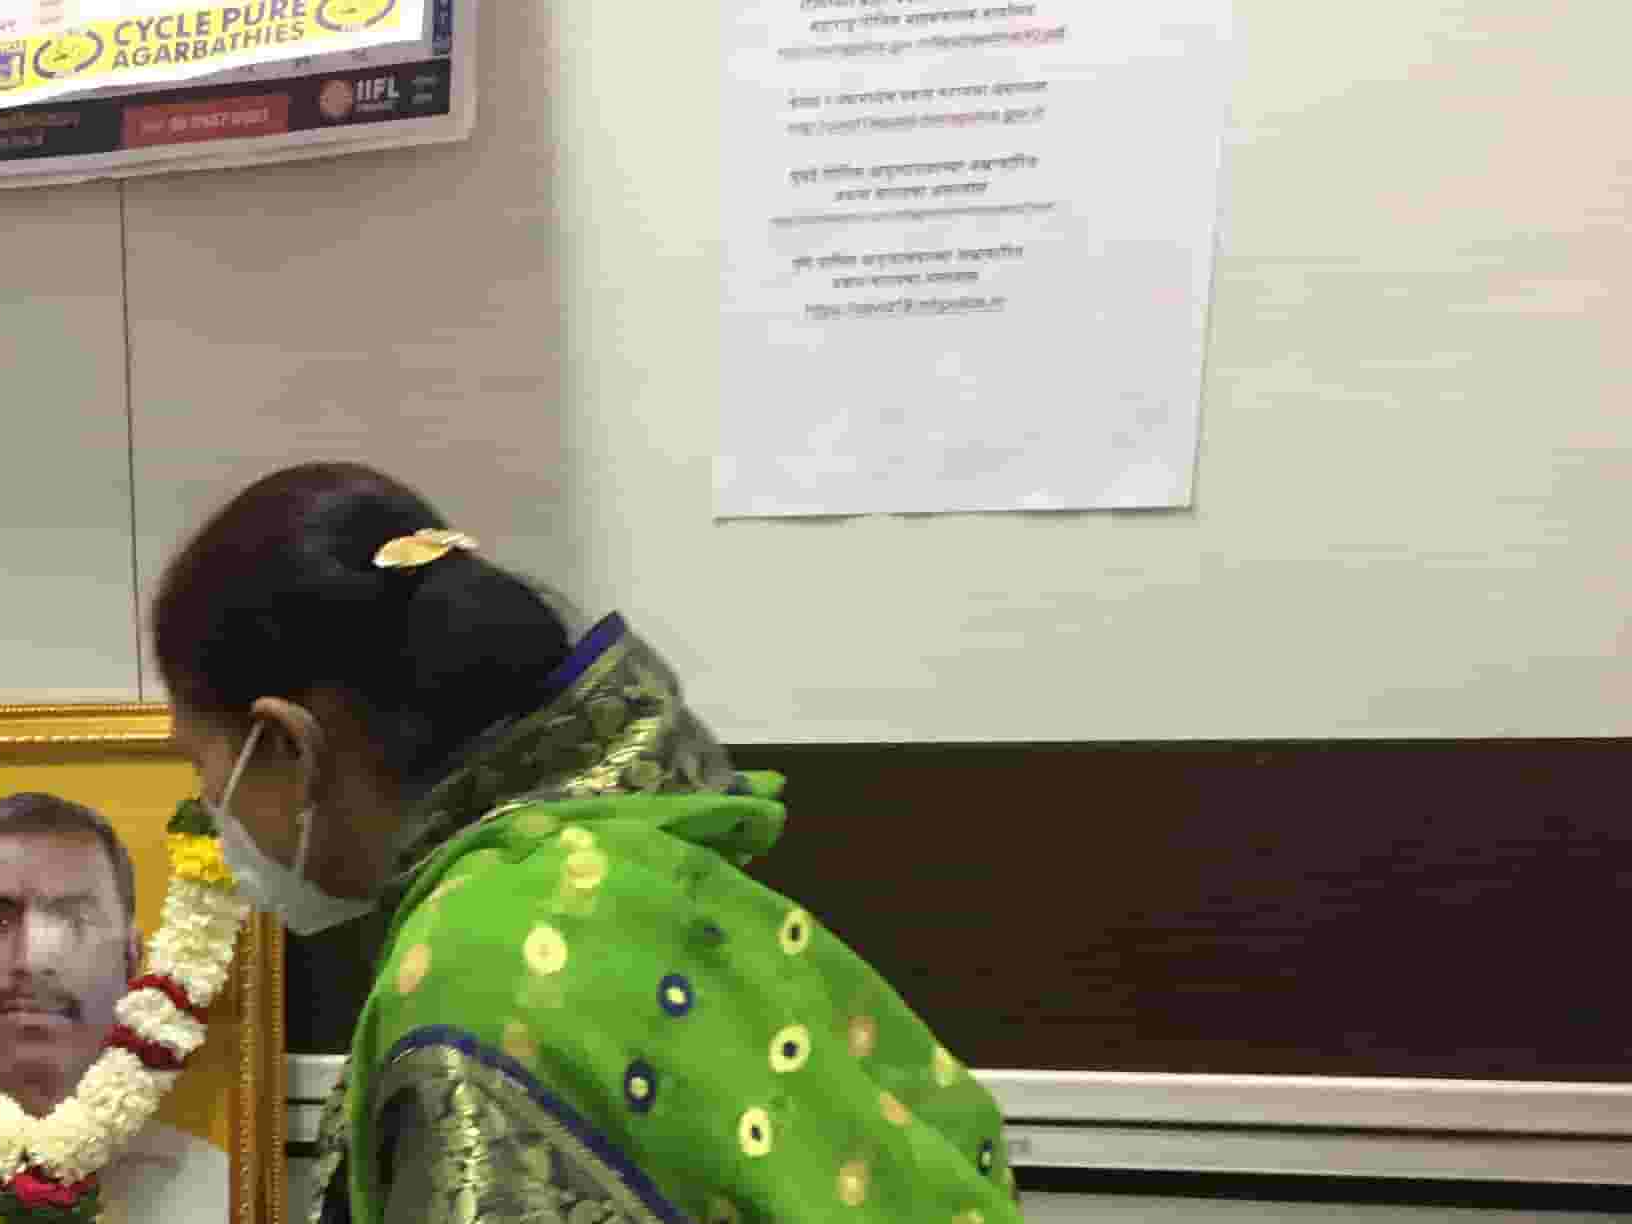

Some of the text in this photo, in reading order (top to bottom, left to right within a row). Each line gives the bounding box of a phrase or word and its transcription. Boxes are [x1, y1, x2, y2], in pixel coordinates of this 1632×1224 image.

[112, 0, 306, 46] CYCLE PURE
[112, 21, 305, 70] AGARBATHIES
[356, 76, 400, 101] IIFL
